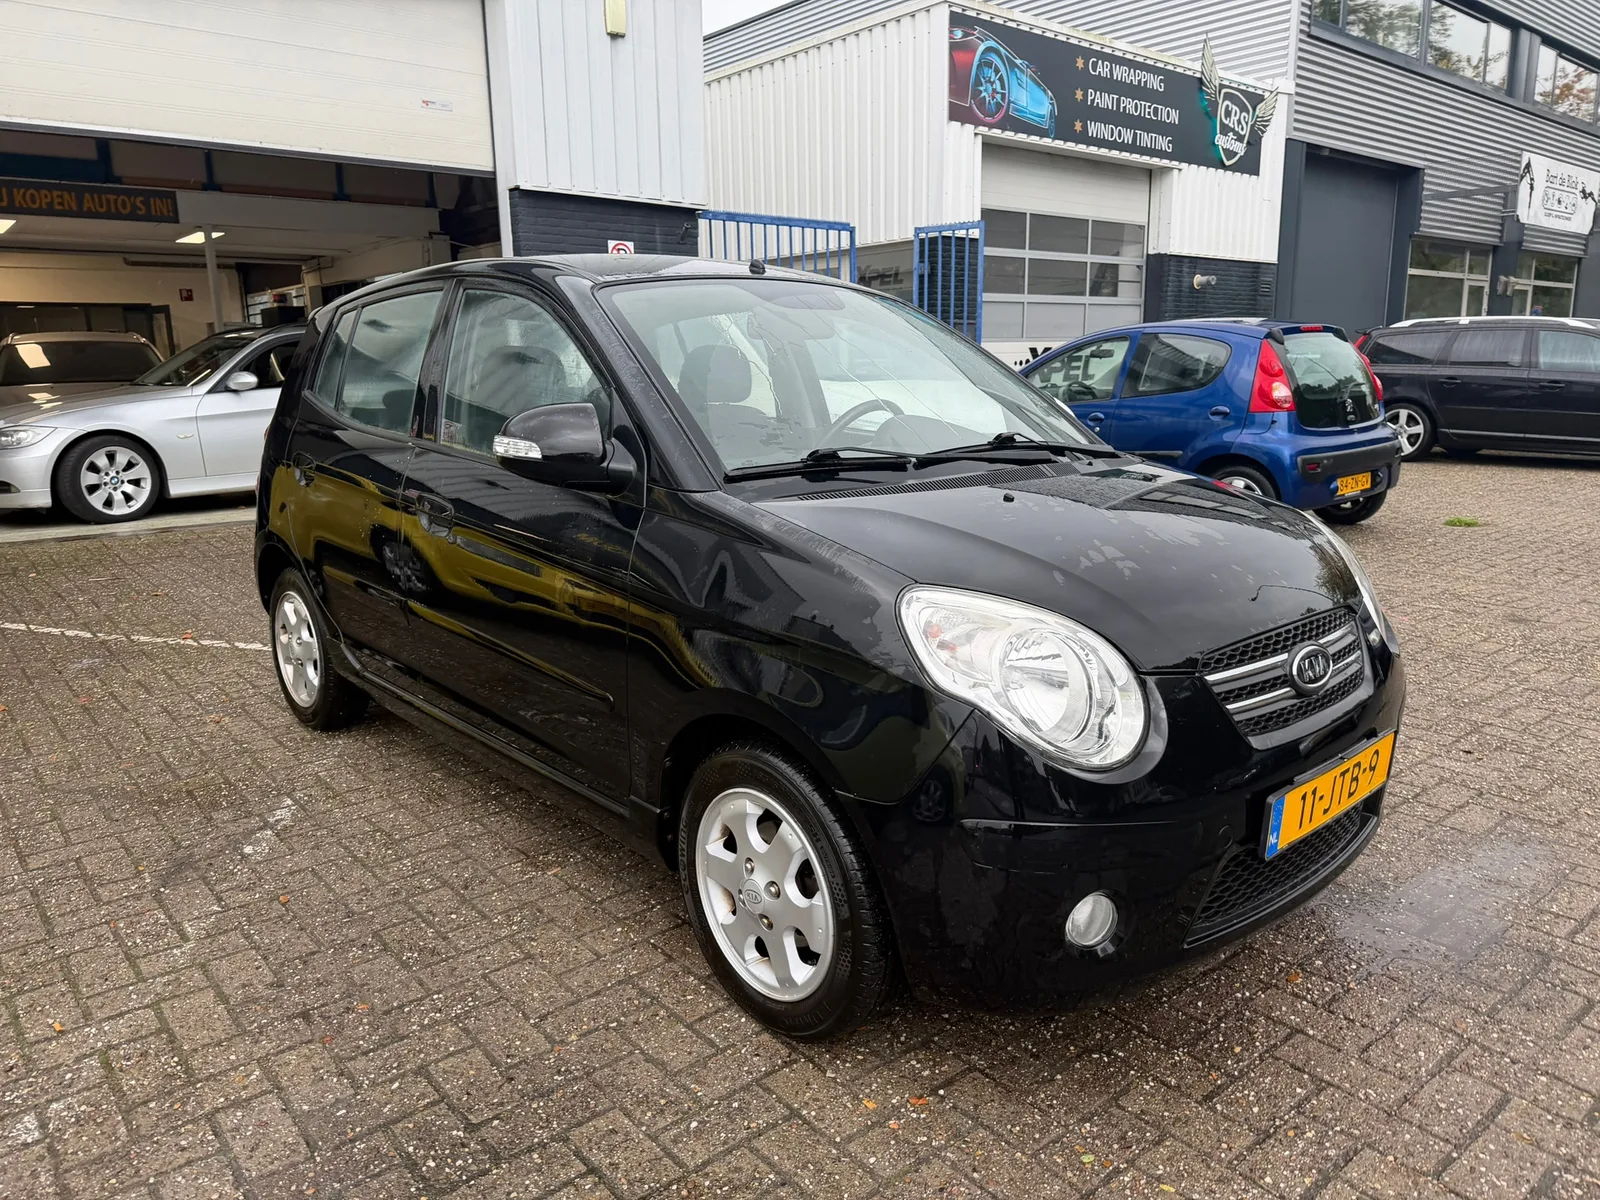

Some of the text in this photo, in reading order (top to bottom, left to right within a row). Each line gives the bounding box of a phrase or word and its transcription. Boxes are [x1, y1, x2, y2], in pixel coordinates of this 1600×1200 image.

[1088, 57, 1165, 92] CAR WRAPPING
[1087, 88, 1179, 125] PAINT PROTECTION
[1221, 100, 1249, 136] CRS
[1087, 120, 1173, 152] WINDOW TINTING
[12, 187, 78, 212] KOPEN
[83, 192, 147, 216] AUTO'S
[150, 198, 174, 217] IN!
[1339, 474, 1370, 492] 84-ZN-GV
[1300, 653, 1329, 682] KIA
[1298, 748, 1380, 831] 11-JTB-9
[1268, 829, 1278, 847] NL
